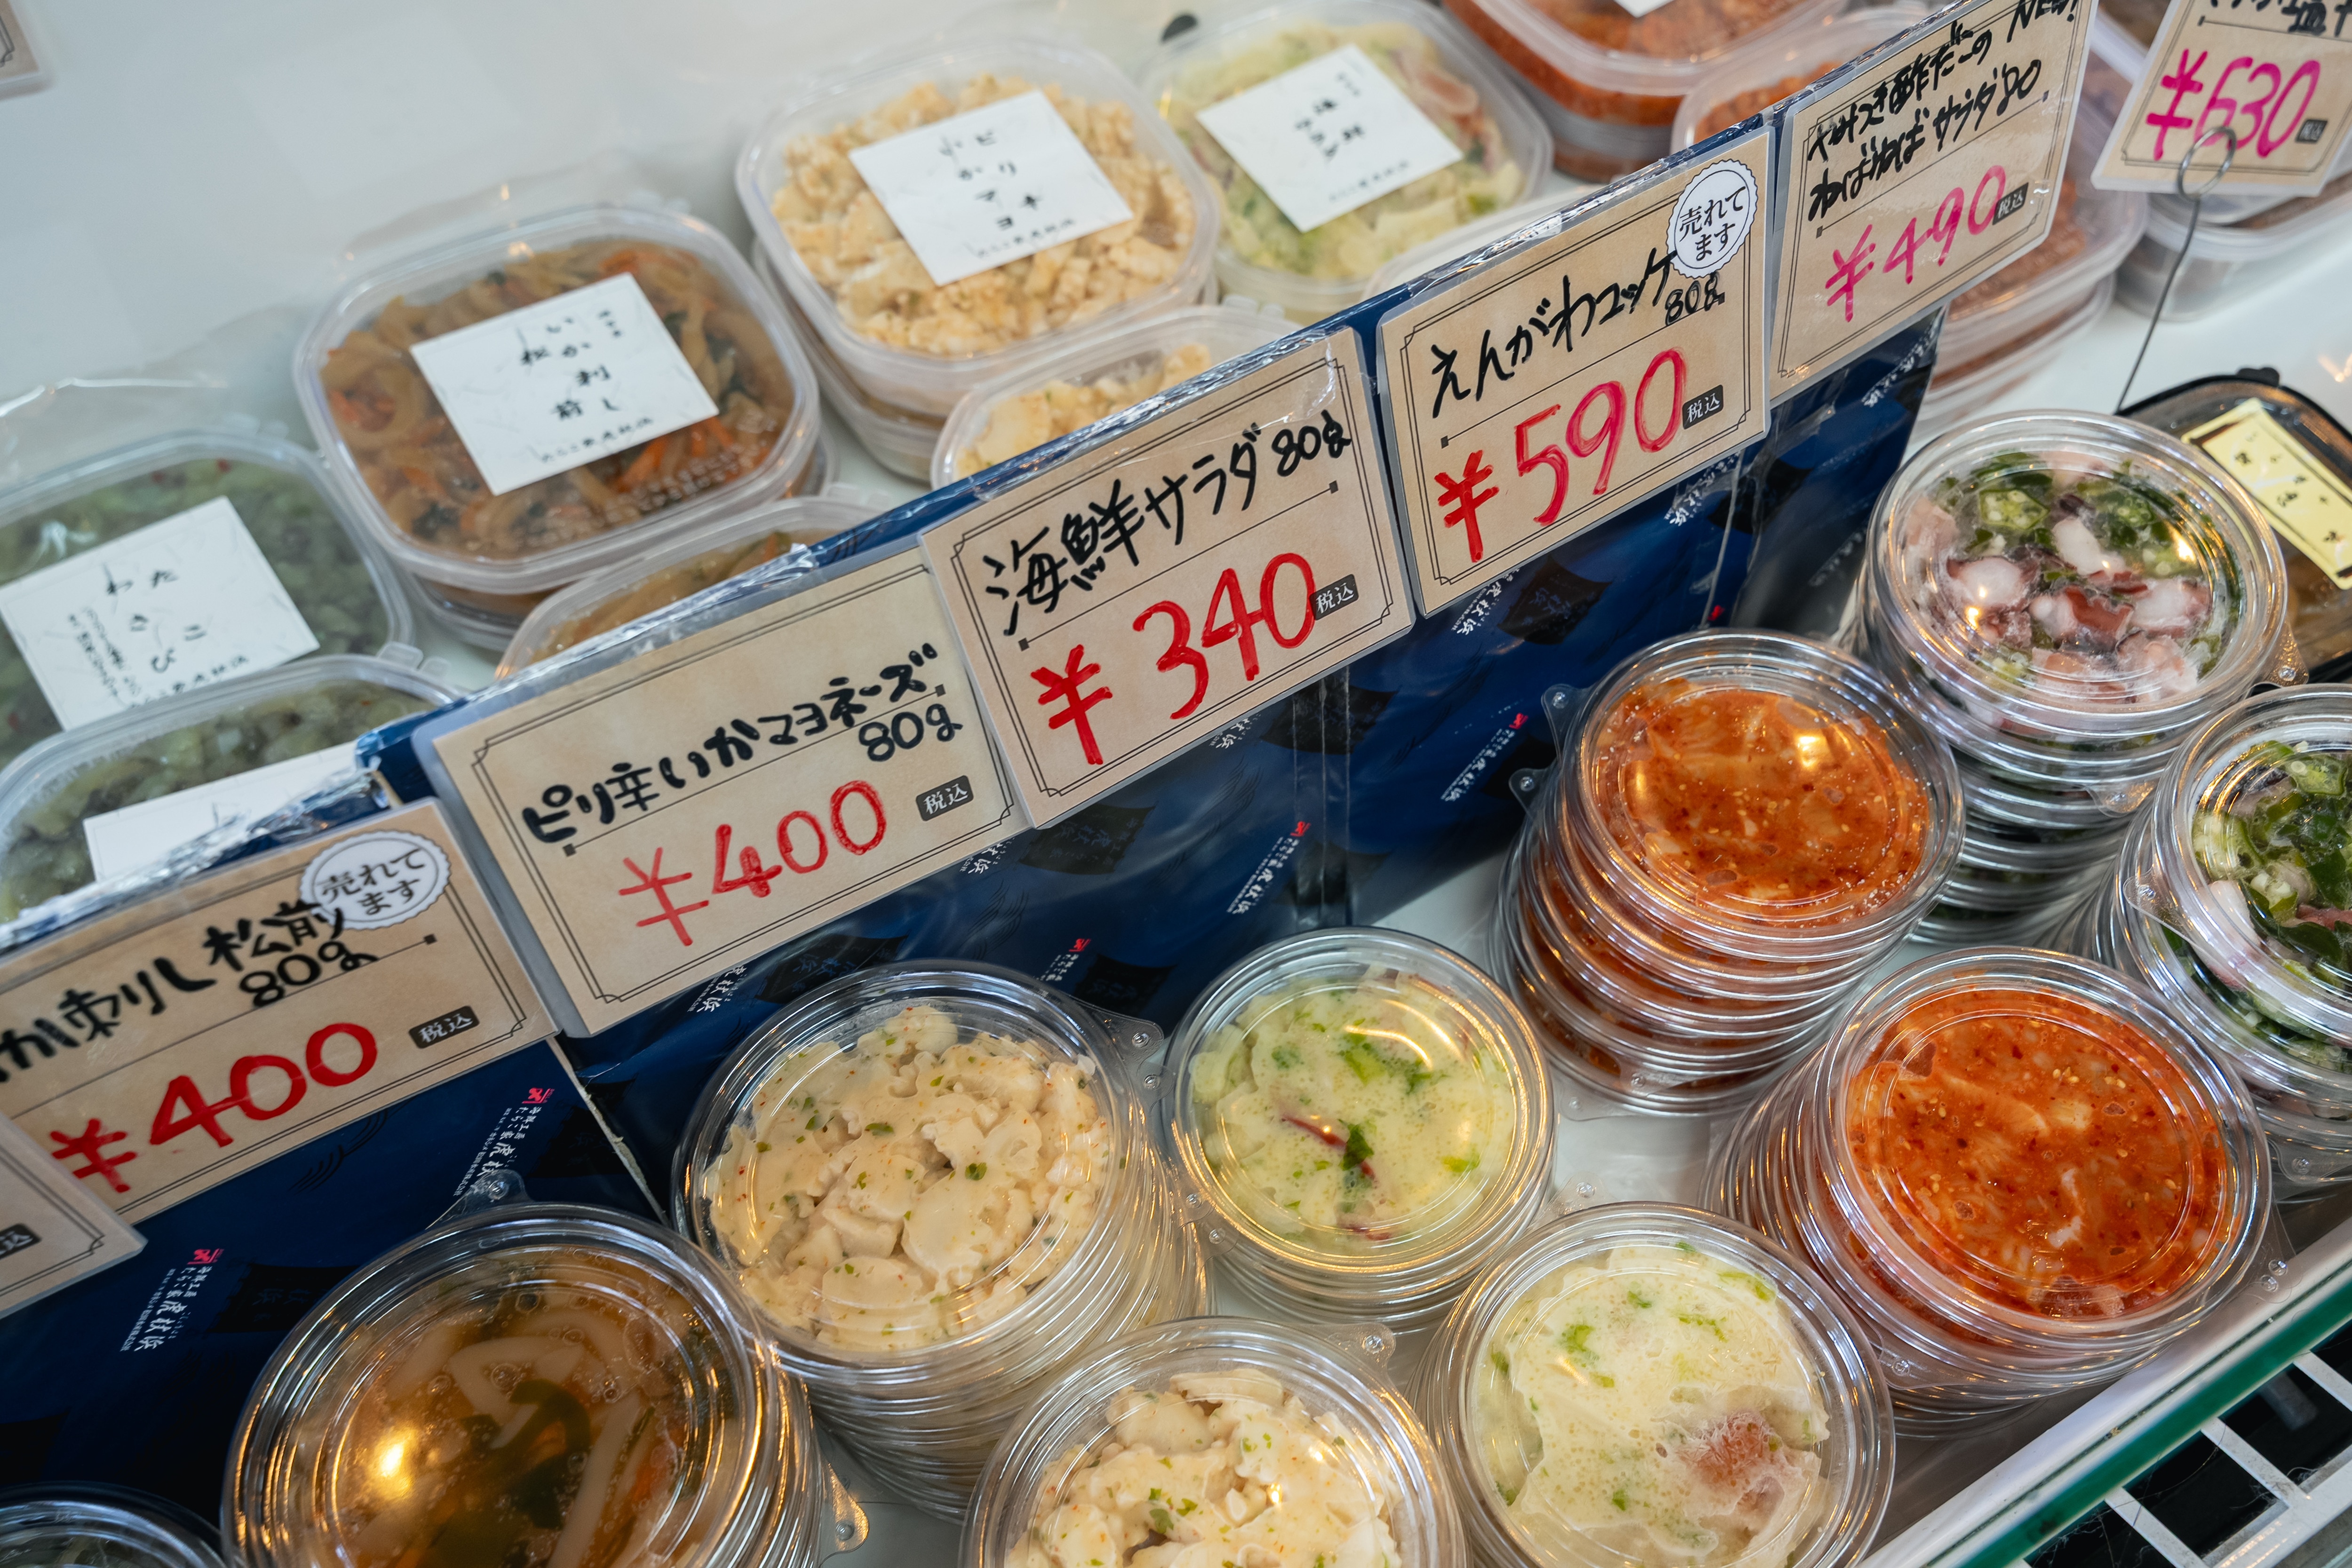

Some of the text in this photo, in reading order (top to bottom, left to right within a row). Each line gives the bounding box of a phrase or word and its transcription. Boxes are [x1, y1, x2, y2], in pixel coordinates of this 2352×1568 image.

[2145, 48, 2321, 161] ¥630
[1678, 185, 1747, 238] 売れて
[1995, 192, 2025, 220] 税込
[1694, 223, 1736, 262] ます
[1825, 165, 2006, 322] ¥490
[1686, 392, 1721, 424] 税込
[1434, 346, 1687, 563] ¥590
[983, 422, 1262, 636] 海鮮サラダ
[1315, 581, 1355, 612] 税込
[1030, 552, 1317, 765] ¥340
[522, 643, 938, 843] ピリ辛いかマヨネーズ
[858, 703, 964, 762] 80g
[922, 782, 969, 815] 税込
[320, 848, 427, 899] 売れて
[618, 780, 888, 947] ¥400
[358, 878, 420, 916] ます
[0, 897, 345, 1083] か刺し松前
[239, 941, 379, 1008] 80g
[418, 1011, 475, 1044] 税込
[49, 1022, 378, 1194] ¥400
